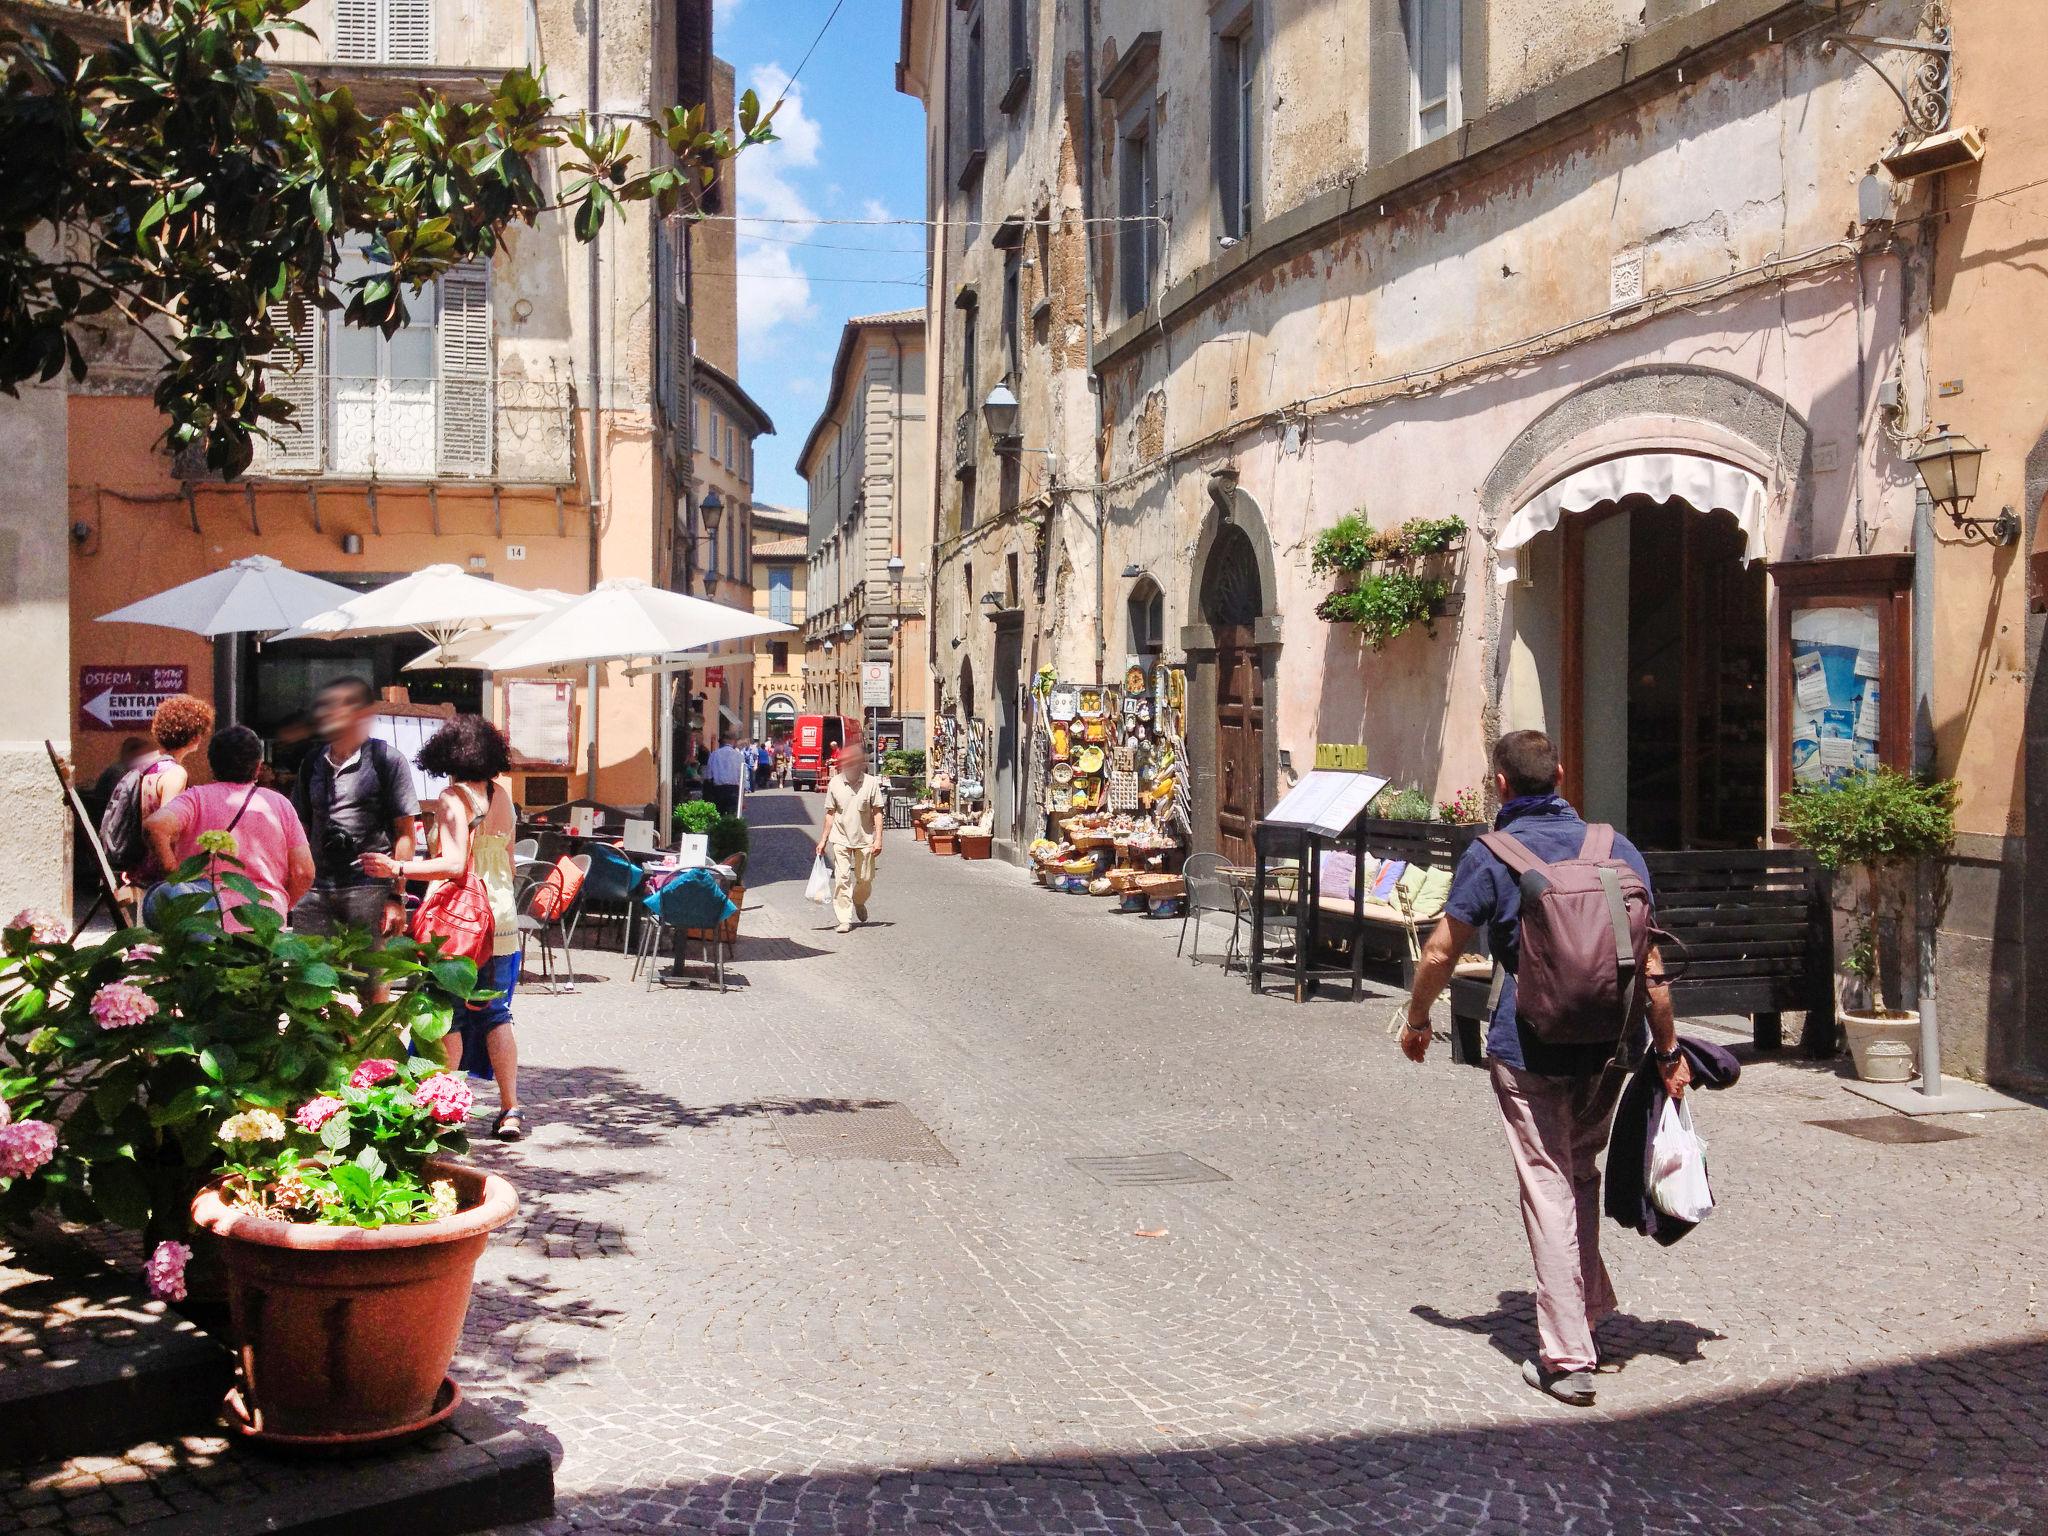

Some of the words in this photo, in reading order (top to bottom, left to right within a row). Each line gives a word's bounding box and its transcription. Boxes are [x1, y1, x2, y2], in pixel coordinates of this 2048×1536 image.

[512, 548, 521, 556] 14
[86, 671, 131, 685] OSTERIA
[757, 683, 806, 692] FARMACIA
[109, 695, 173, 707] ENTRAN
[109, 709, 143, 717] INSIDE
